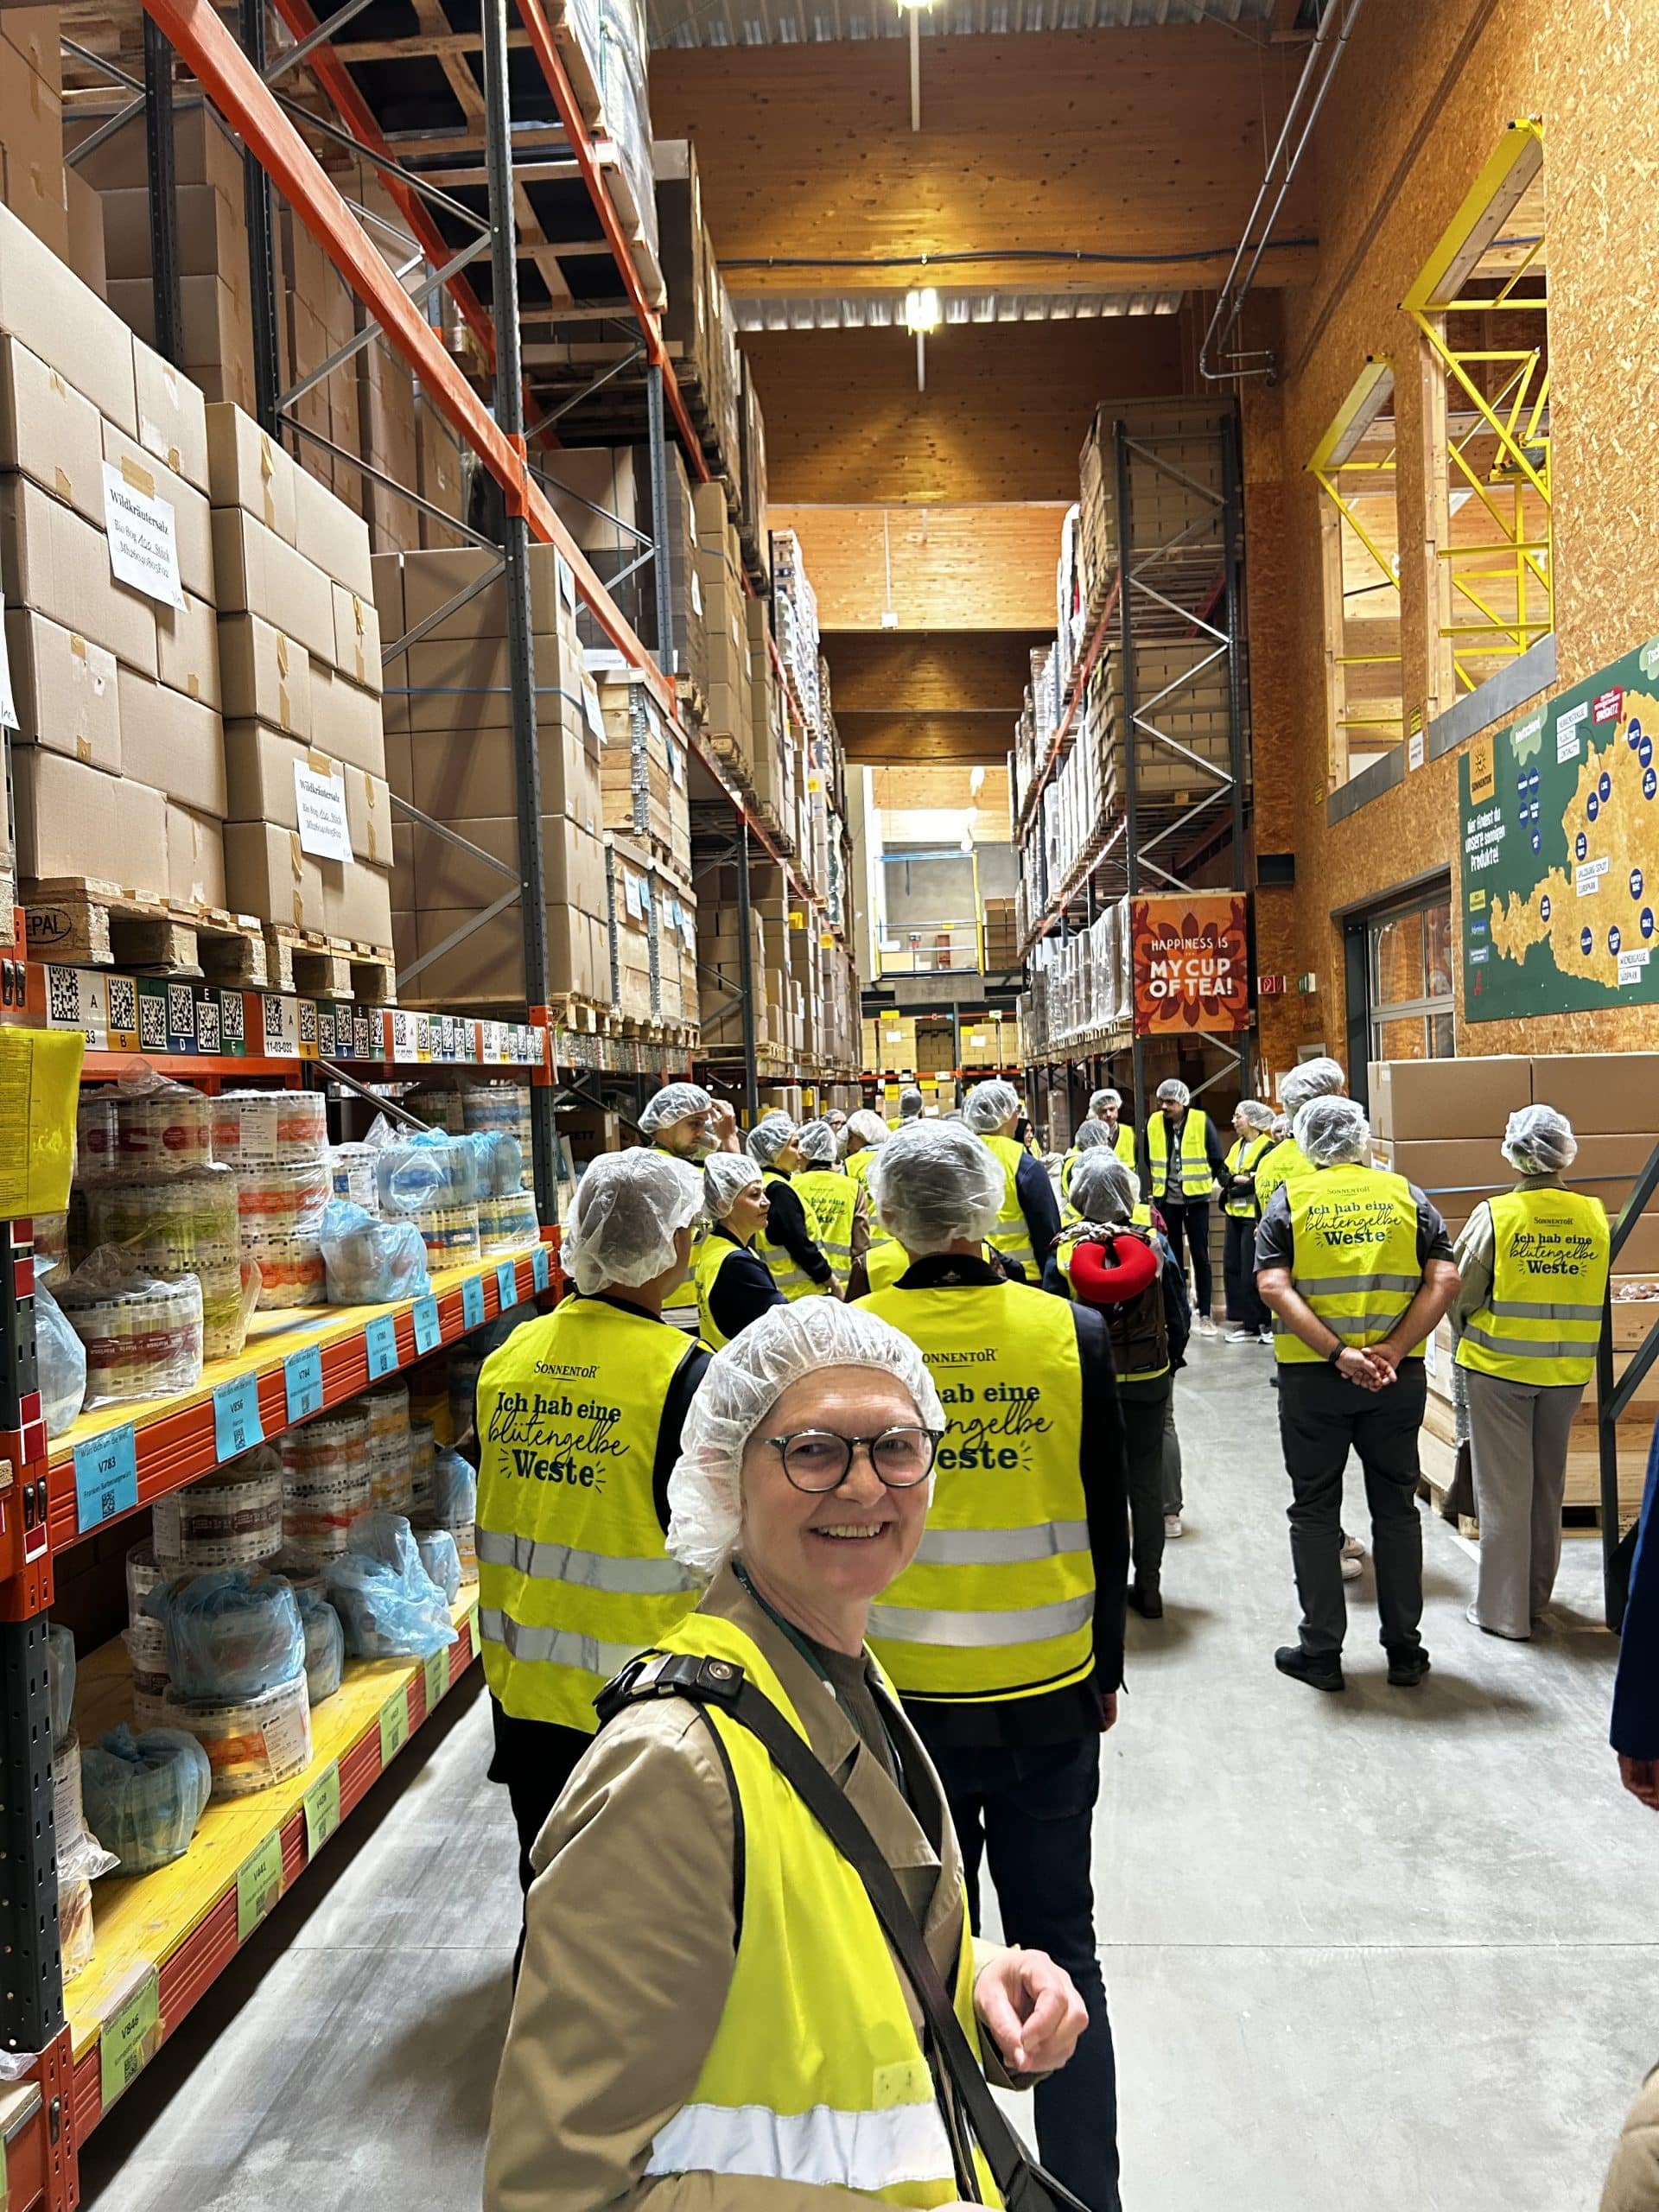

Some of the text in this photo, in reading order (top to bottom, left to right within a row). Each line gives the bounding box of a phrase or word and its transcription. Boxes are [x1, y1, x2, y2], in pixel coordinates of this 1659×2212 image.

[110, 488, 168, 535] Wildkräutersalz
[114, 518, 125, 533] Bio
[299, 779, 340, 803] Wildkräutersalz
[1477, 810, 1493, 832] findest
[1493, 805, 1501, 823] du
[1465, 830, 1484, 854] unsere
[1484, 824, 1505, 847] sonnigen
[1471, 845, 1499, 873] Produkte!
[1151, 937, 1228, 951] HAPPINESS IS
[1150, 958, 1230, 979] MY CUP
[204, 988, 210, 1000] E
[1149, 977, 1232, 998] OF TEA!
[90, 995, 98, 1008] A
[289, 1014, 294, 1026] A
[119, 1035, 127, 1047] B
[179, 1038, 186, 1052] D
[231, 1042, 236, 1053] F
[266, 1040, 293, 1053] 11-03-032
[1308, 1200, 1395, 1216] Ich hab eine
[1323, 1230, 1386, 1246] Weste
[1514, 1232, 1592, 1245] Ich hab eine
[1526, 1260, 1580, 1274] Weste
[922, 1349, 996, 1363] ONNENTOR
[534, 1361, 598, 1378] SONNENTOR
[983, 1382, 1040, 1402] eine
[498, 1392, 621, 1423] Ich hab eine
[945, 1402, 1053, 1453] ngelbe
[488, 1409, 630, 1465] blütengelbe
[938, 1441, 1019, 1470] este
[98, 1457, 116, 1473] V783
[512, 1449, 594, 1487] Weste
[121, 2013, 139, 2040] V846
